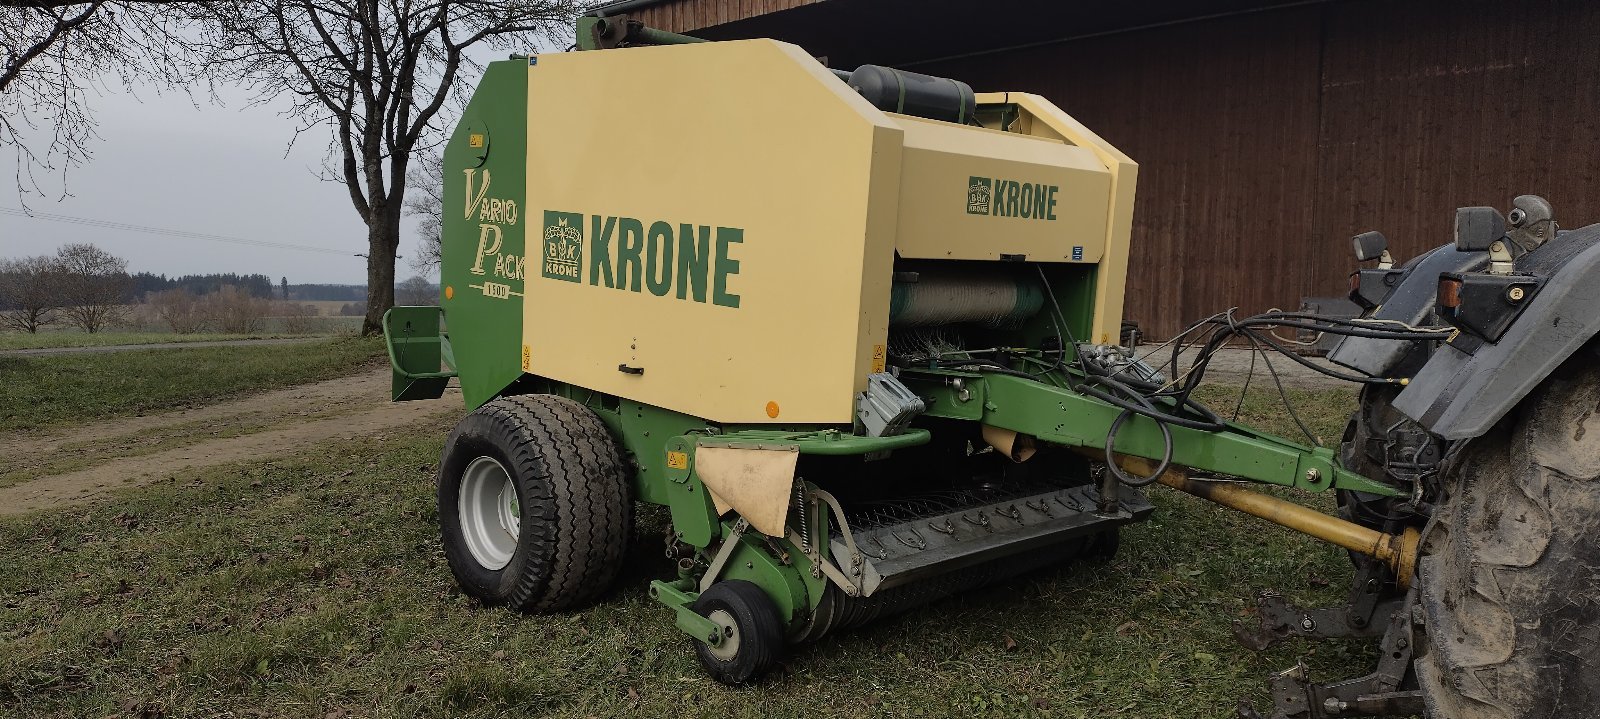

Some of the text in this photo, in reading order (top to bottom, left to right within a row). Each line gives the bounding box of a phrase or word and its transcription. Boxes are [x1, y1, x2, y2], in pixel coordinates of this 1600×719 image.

[993, 179, 1058, 220] KRONE
[546, 262, 578, 278] KRONE
[589, 214, 744, 309] KRONE
[487, 284, 507, 298] 1500
